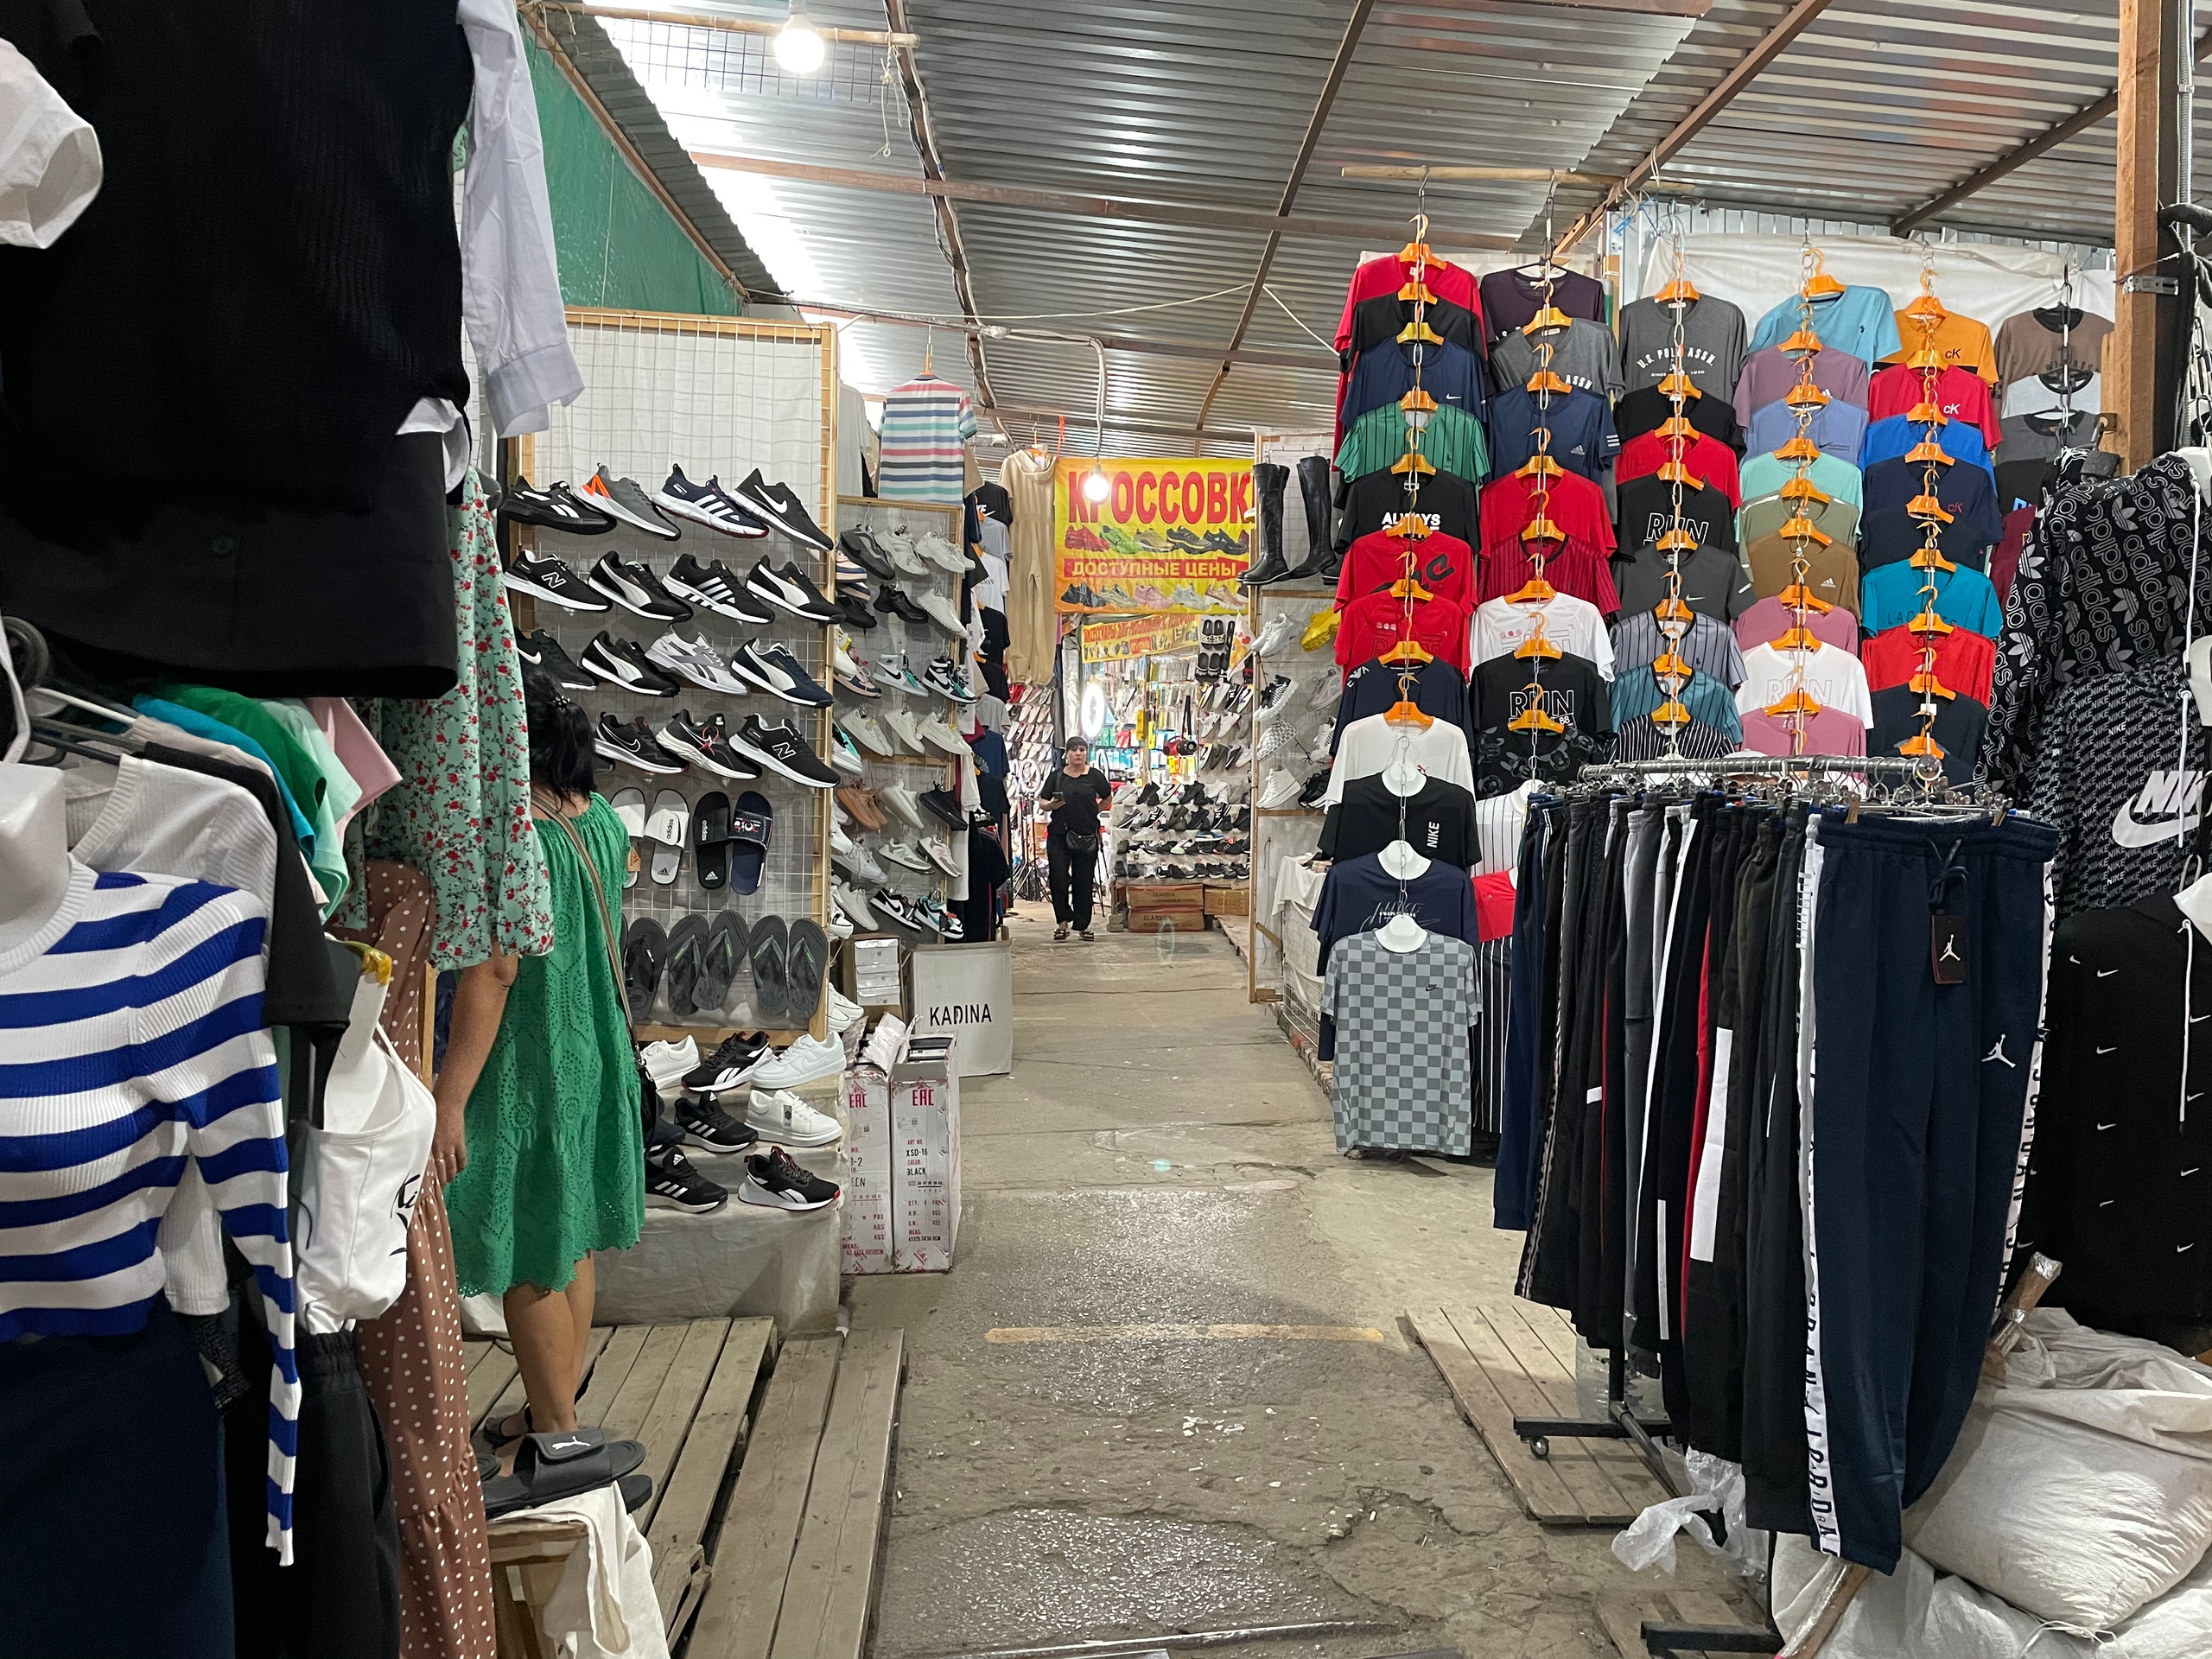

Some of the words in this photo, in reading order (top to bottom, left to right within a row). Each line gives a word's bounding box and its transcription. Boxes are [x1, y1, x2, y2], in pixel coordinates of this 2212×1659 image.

[1637, 353, 1655, 369] U.S.
[1381, 512, 1441, 526] ALYS
[1071, 562, 1181, 578] ДОСТУПНЫЕ
[1185, 562, 1236, 578] ЦЕНЫ
[1510, 690, 1574, 718] RUN
[2108, 721, 2126, 735] NIKE
[2082, 803, 2097, 818] NIKE
[1427, 822, 1440, 849] NIKE
[2107, 870, 2125, 886] NIKE
[930, 1003, 992, 1027] KADINA
[849, 1093, 868, 1108] EAC
[912, 1089, 935, 1106] EAC
[906, 1147, 928, 1157] XSD-16
[906, 1167, 927, 1176] BLACK
